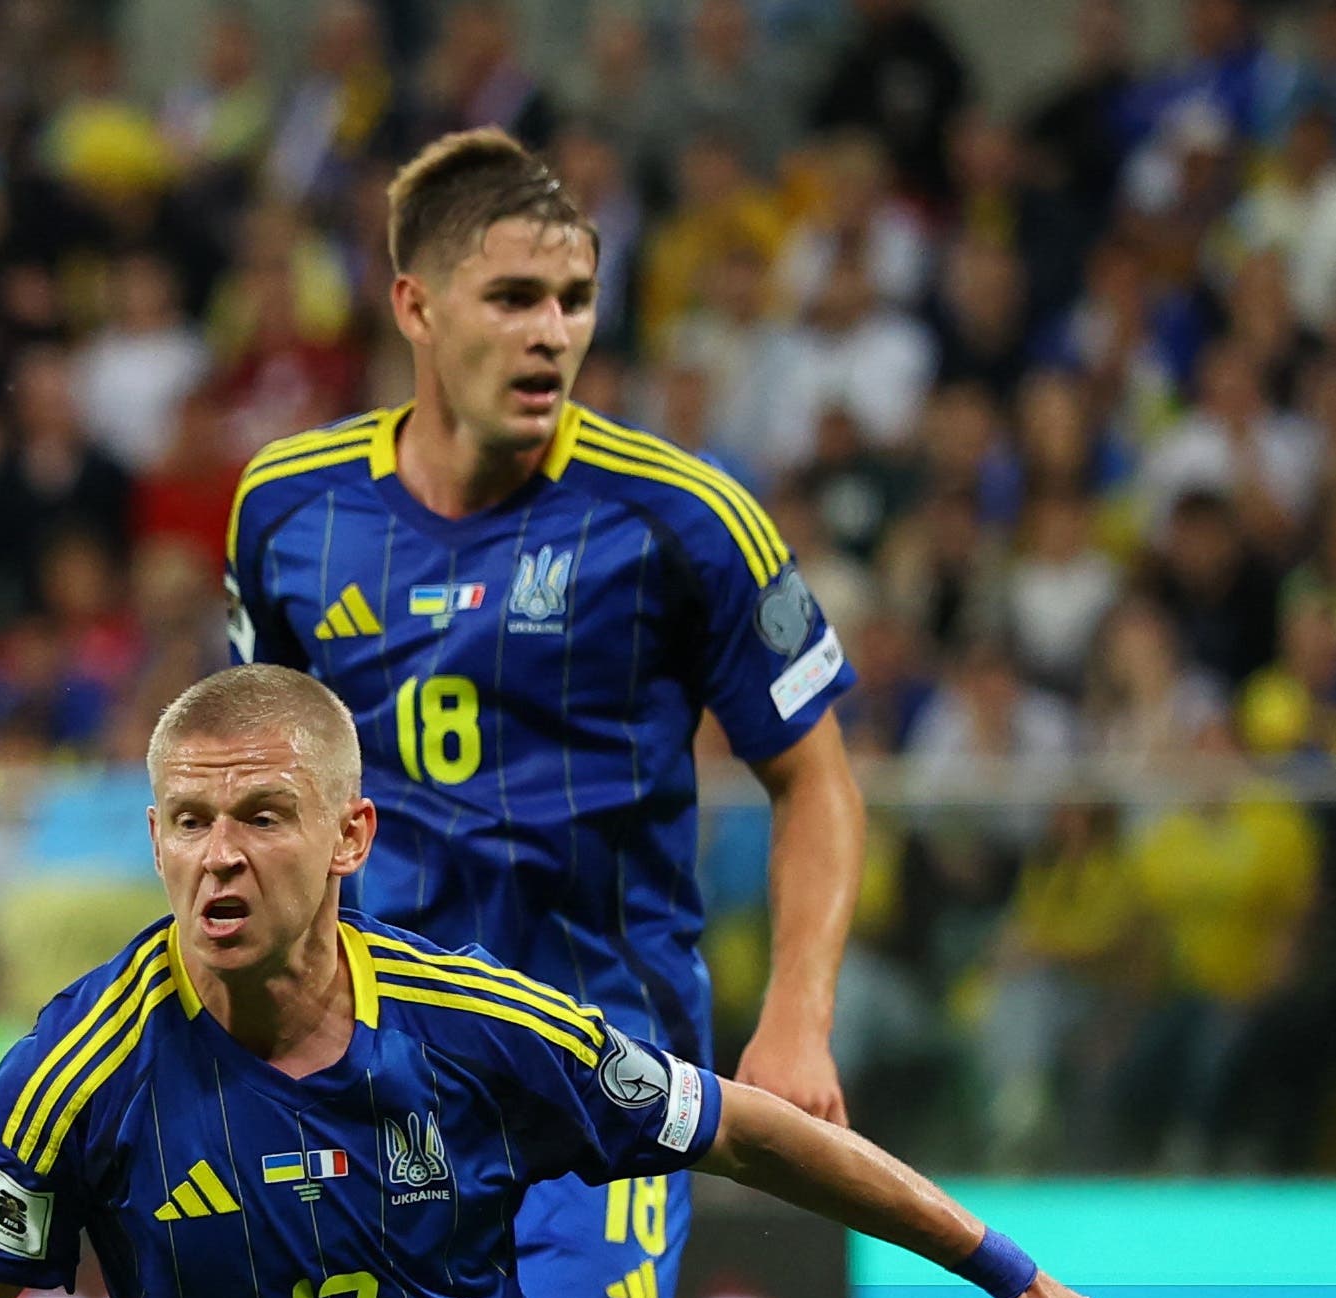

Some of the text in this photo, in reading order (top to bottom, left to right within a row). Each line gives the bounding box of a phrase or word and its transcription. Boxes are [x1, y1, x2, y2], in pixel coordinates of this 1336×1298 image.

[396, 674, 482, 785] 18
[391, 1189, 450, 1206] UKRAINE
[604, 1175, 668, 1257] 18
